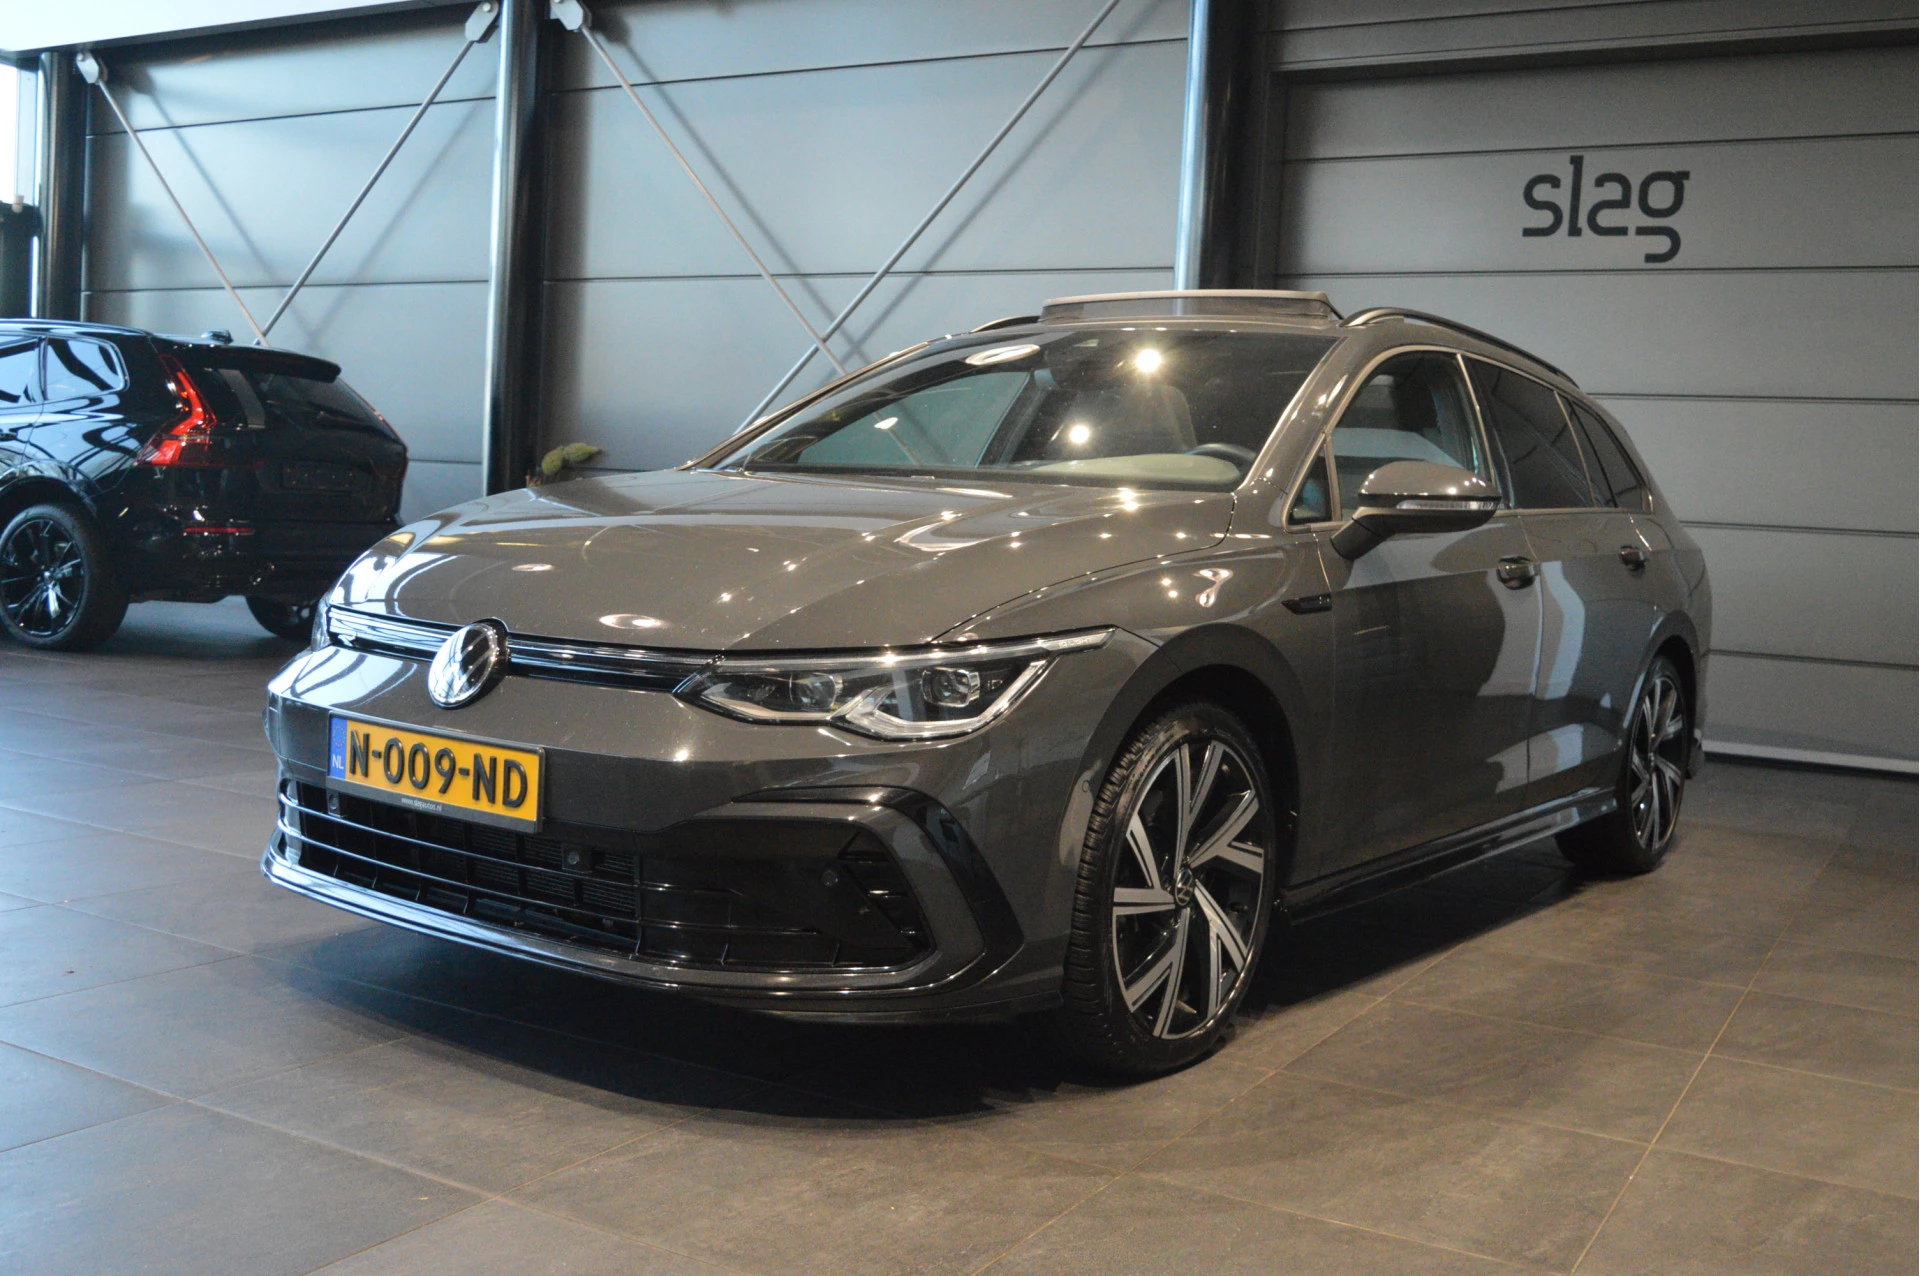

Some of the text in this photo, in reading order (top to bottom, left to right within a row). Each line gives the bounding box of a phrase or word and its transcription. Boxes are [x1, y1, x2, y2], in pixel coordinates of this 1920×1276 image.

[1522, 154, 1690, 263] slag
[332, 754, 345, 769] NL
[349, 730, 528, 809] N-009-ND
